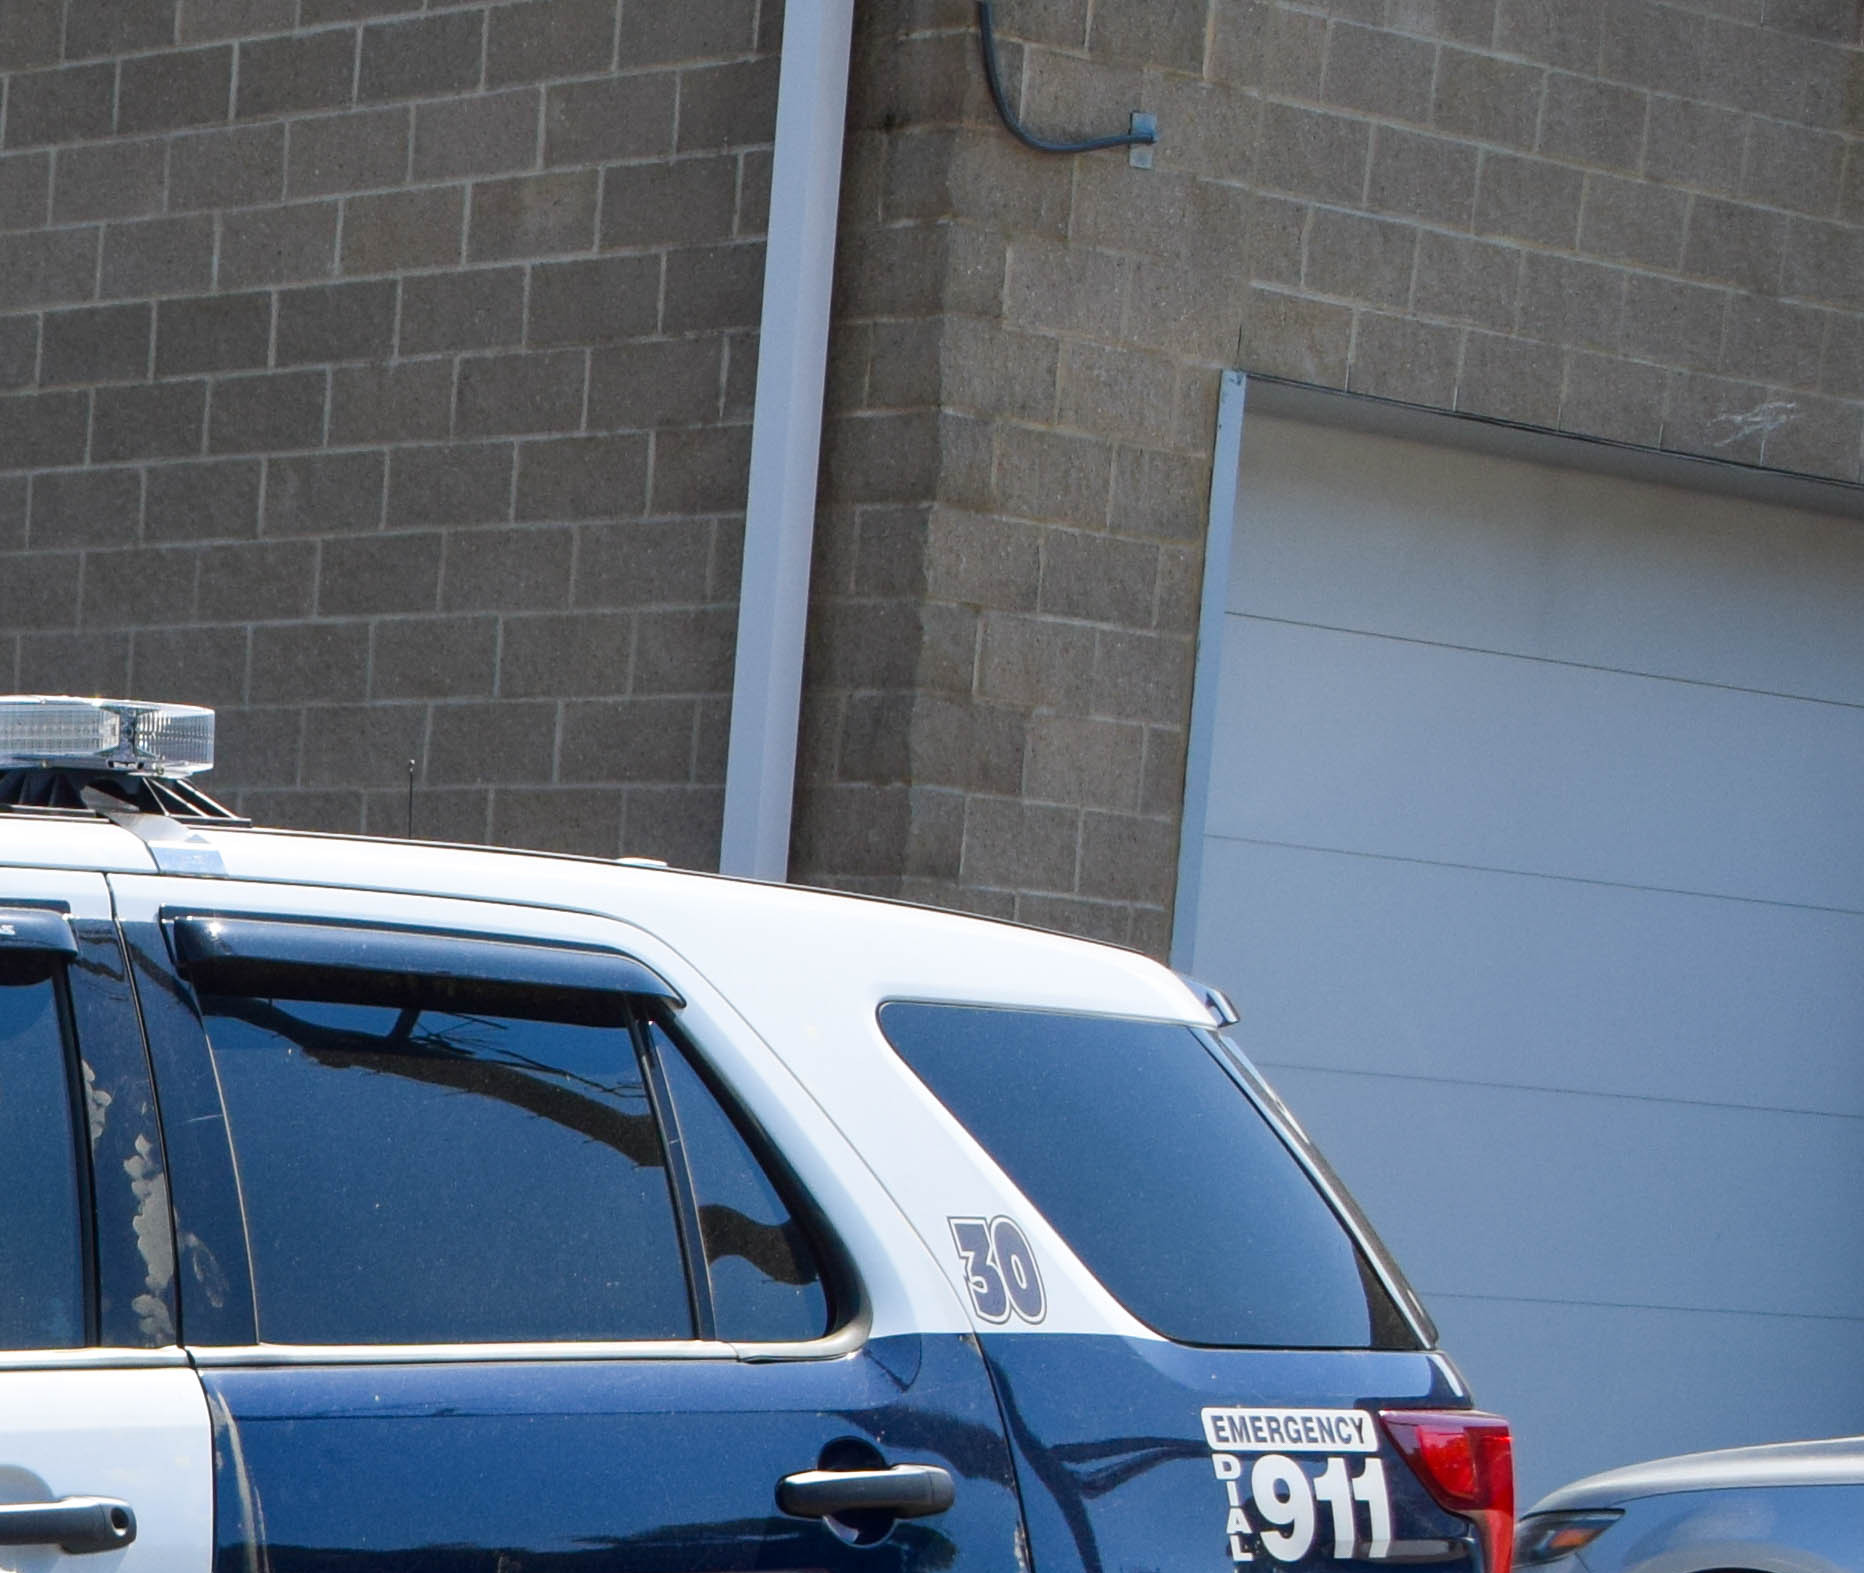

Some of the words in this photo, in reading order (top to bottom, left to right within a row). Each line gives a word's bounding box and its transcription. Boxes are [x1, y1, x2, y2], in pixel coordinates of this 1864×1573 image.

[947, 1214, 1048, 1325] 30
[1210, 1414, 1365, 1445] EMERGENCY
[1211, 1453, 1254, 1562] DIAL
[1251, 1453, 1392, 1562] 911
